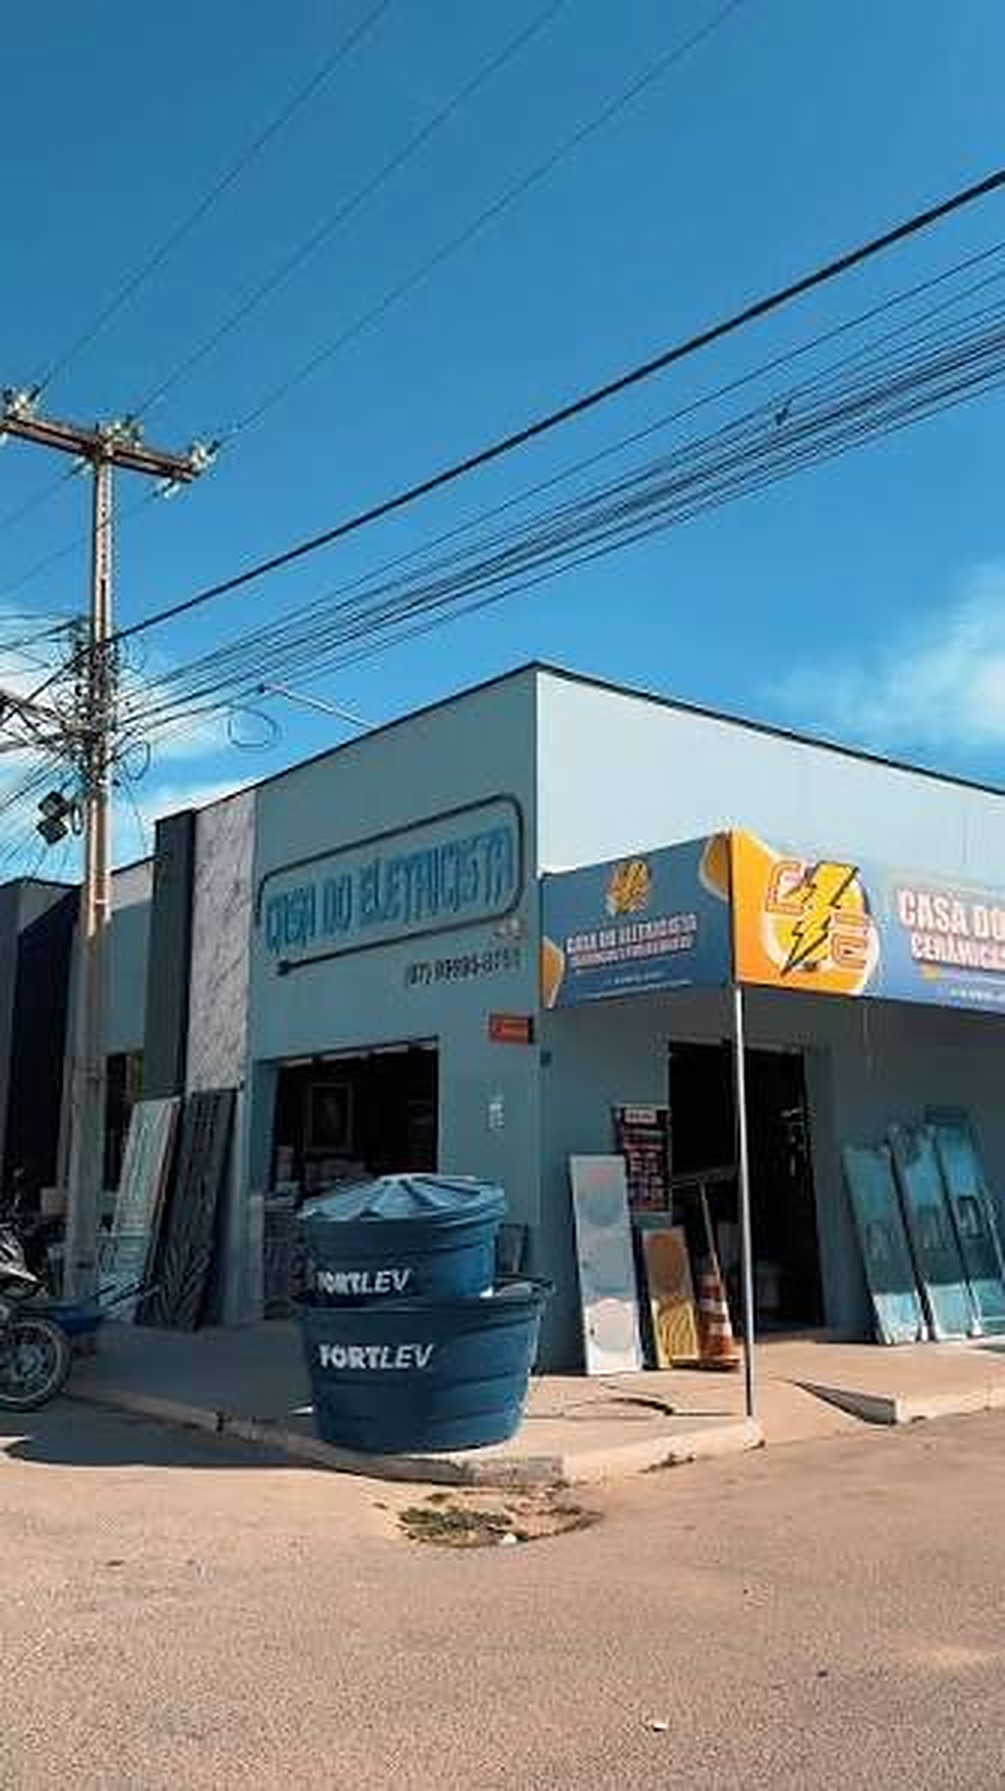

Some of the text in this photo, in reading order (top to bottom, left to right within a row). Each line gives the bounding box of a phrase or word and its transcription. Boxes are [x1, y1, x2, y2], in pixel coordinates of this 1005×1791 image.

[898, 890, 969, 937] CASA
[317, 1268, 412, 1295] FORTLEV
[319, 1343, 435, 1369] FORTLEV
